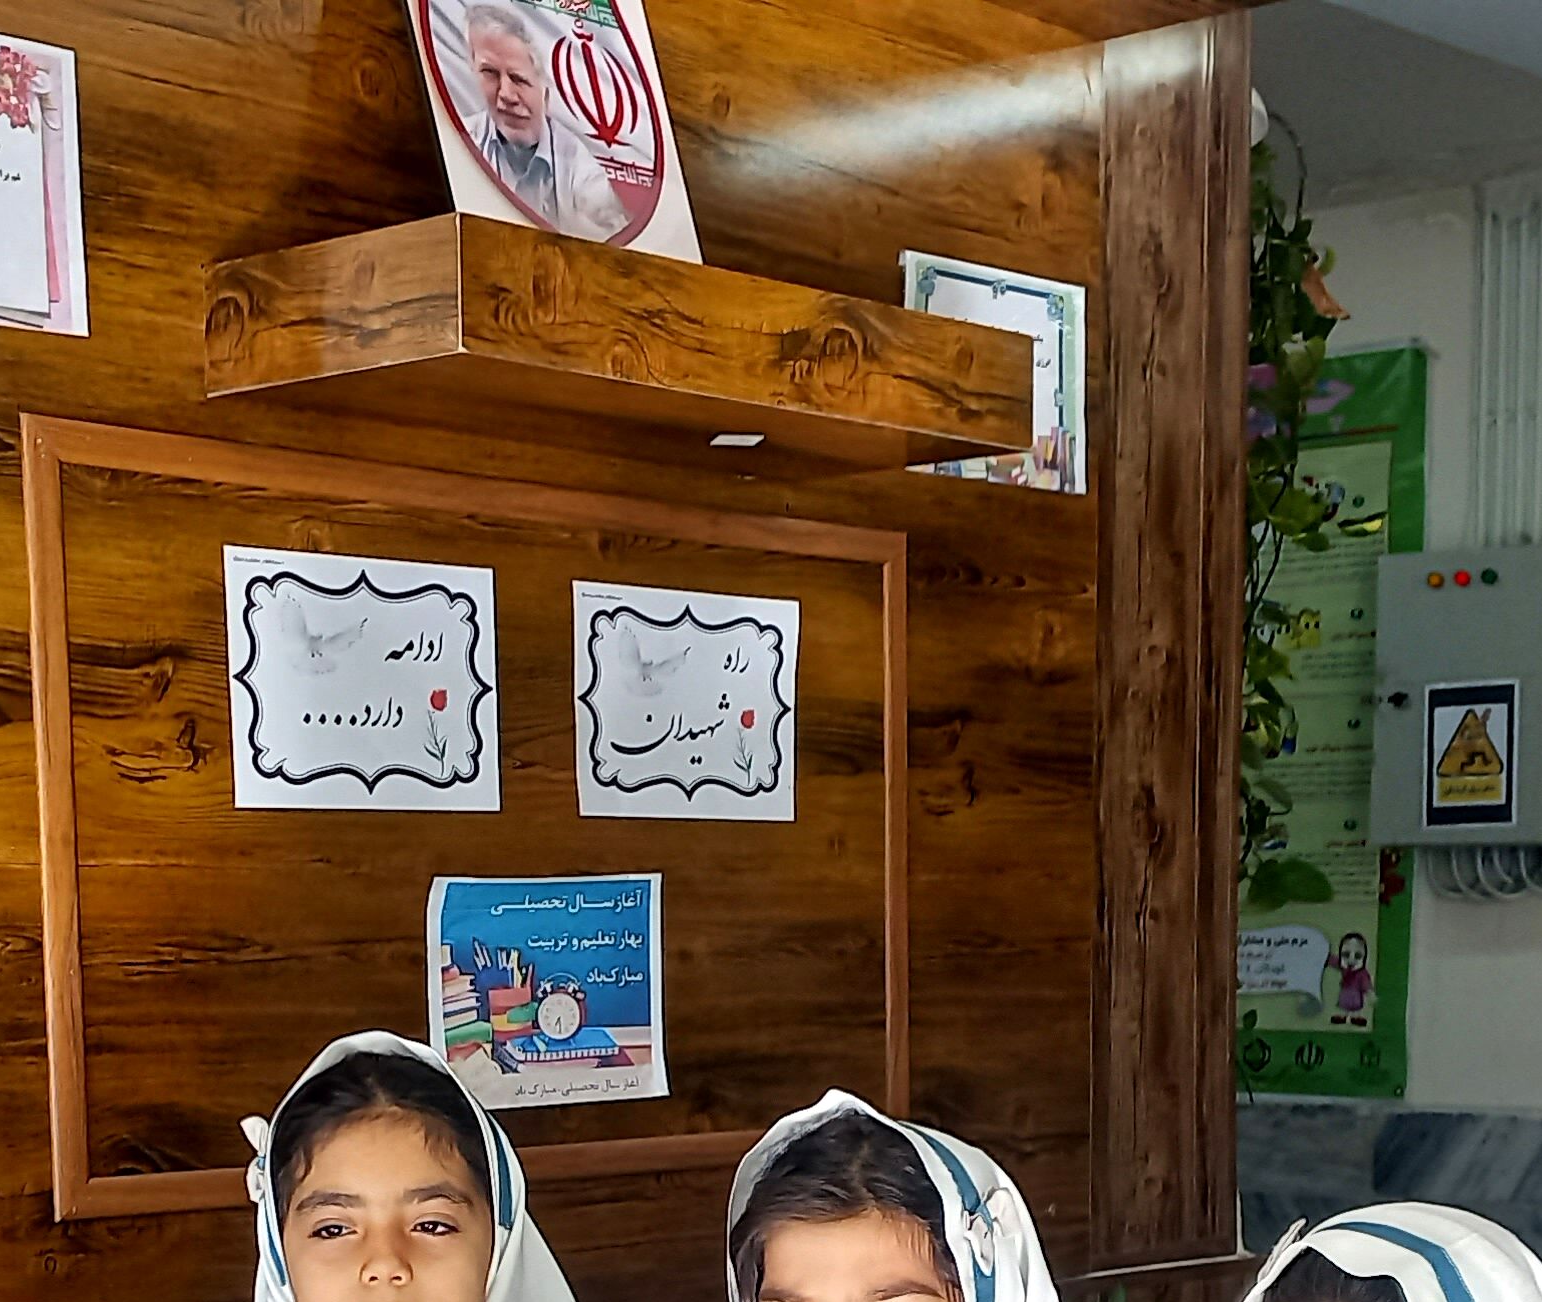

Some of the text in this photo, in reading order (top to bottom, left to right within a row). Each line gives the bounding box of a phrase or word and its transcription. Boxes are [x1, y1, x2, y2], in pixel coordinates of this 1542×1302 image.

[384, 630, 443, 664] ادامه
[723, 645, 751, 674] راه
[609, 692, 730, 766] شهیدان
[490, 890, 642, 915] آغاز سال تحصیلی
[528, 930, 643, 951] بهار تعلیم و تربیت
